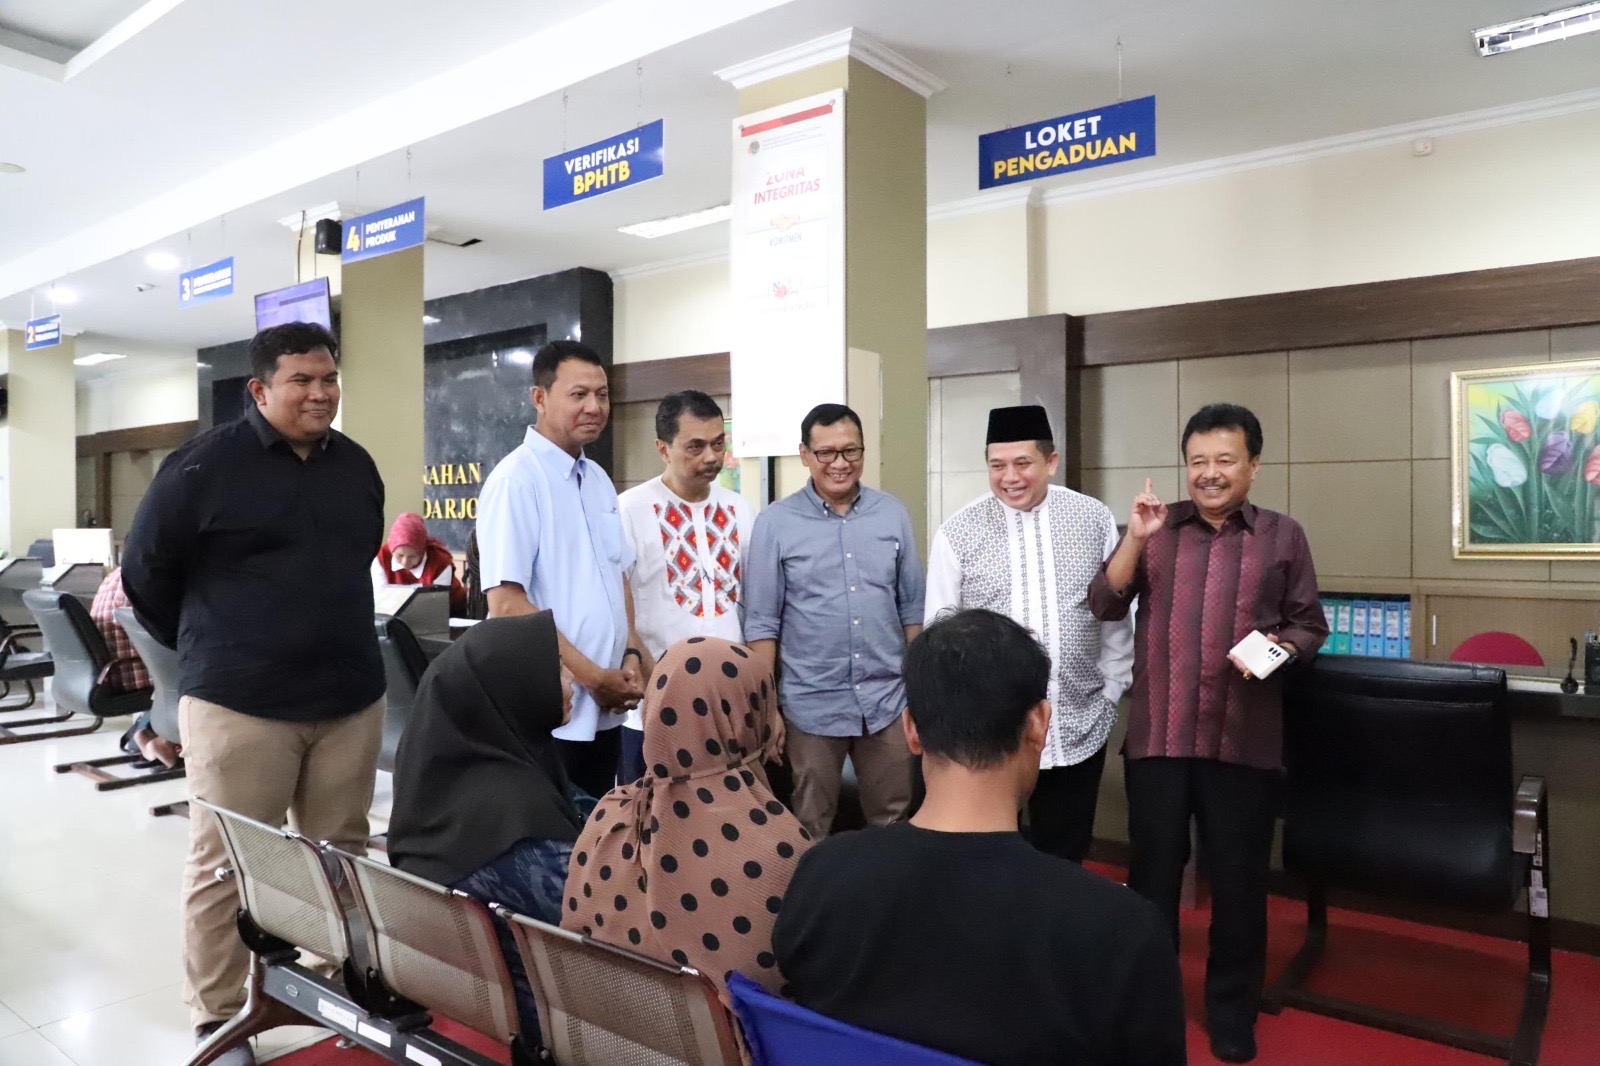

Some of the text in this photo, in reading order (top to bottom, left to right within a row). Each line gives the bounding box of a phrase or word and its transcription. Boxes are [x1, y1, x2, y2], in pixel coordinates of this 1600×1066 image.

[1025, 115, 1101, 150] LOKET
[564, 137, 639, 175] VERIFIKASI
[993, 132, 1136, 180] PENGADUAN
[573, 160, 631, 196] BPHTB
[754, 178, 821, 205] INTEGRITAS
[346, 226, 360, 252] 4
[365, 230, 397, 248] PRODUK
[182, 278, 191, 301] 3
[27, 326, 34, 343] 2
